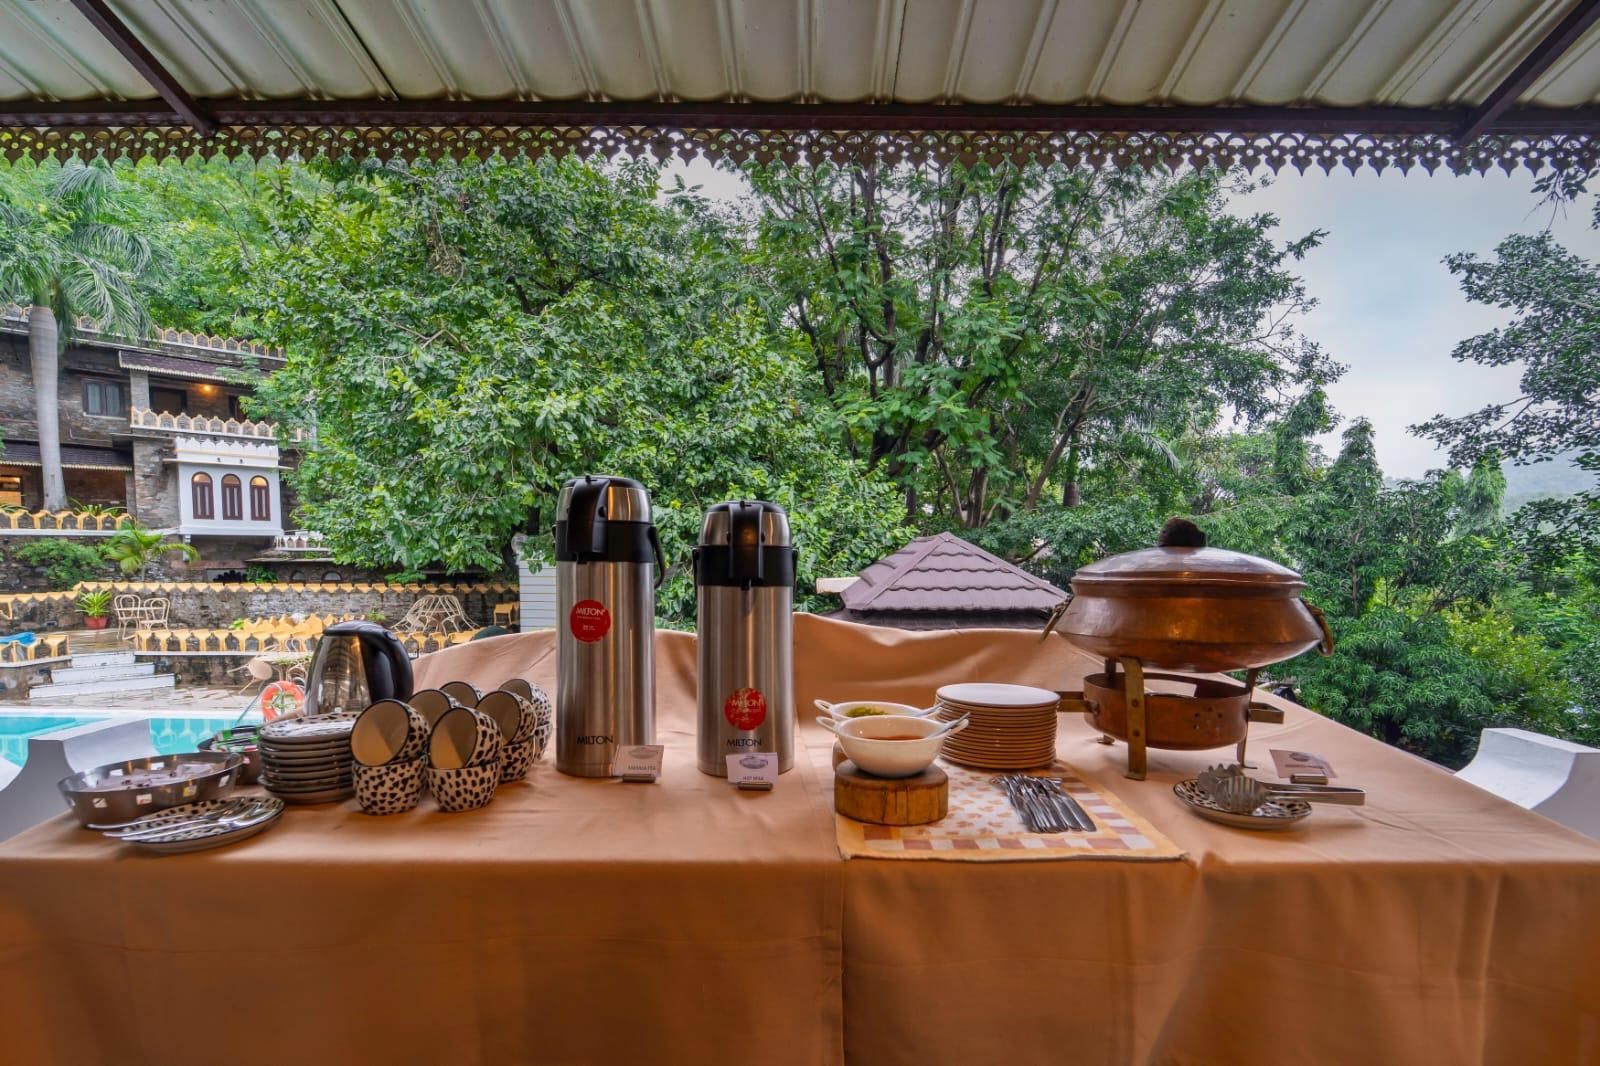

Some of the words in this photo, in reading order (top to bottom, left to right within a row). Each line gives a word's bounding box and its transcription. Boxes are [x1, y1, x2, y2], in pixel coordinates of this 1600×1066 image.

[576, 607, 604, 616] MILTON
[577, 735, 613, 745] MILTON
[727, 738, 762, 746] MILTON
